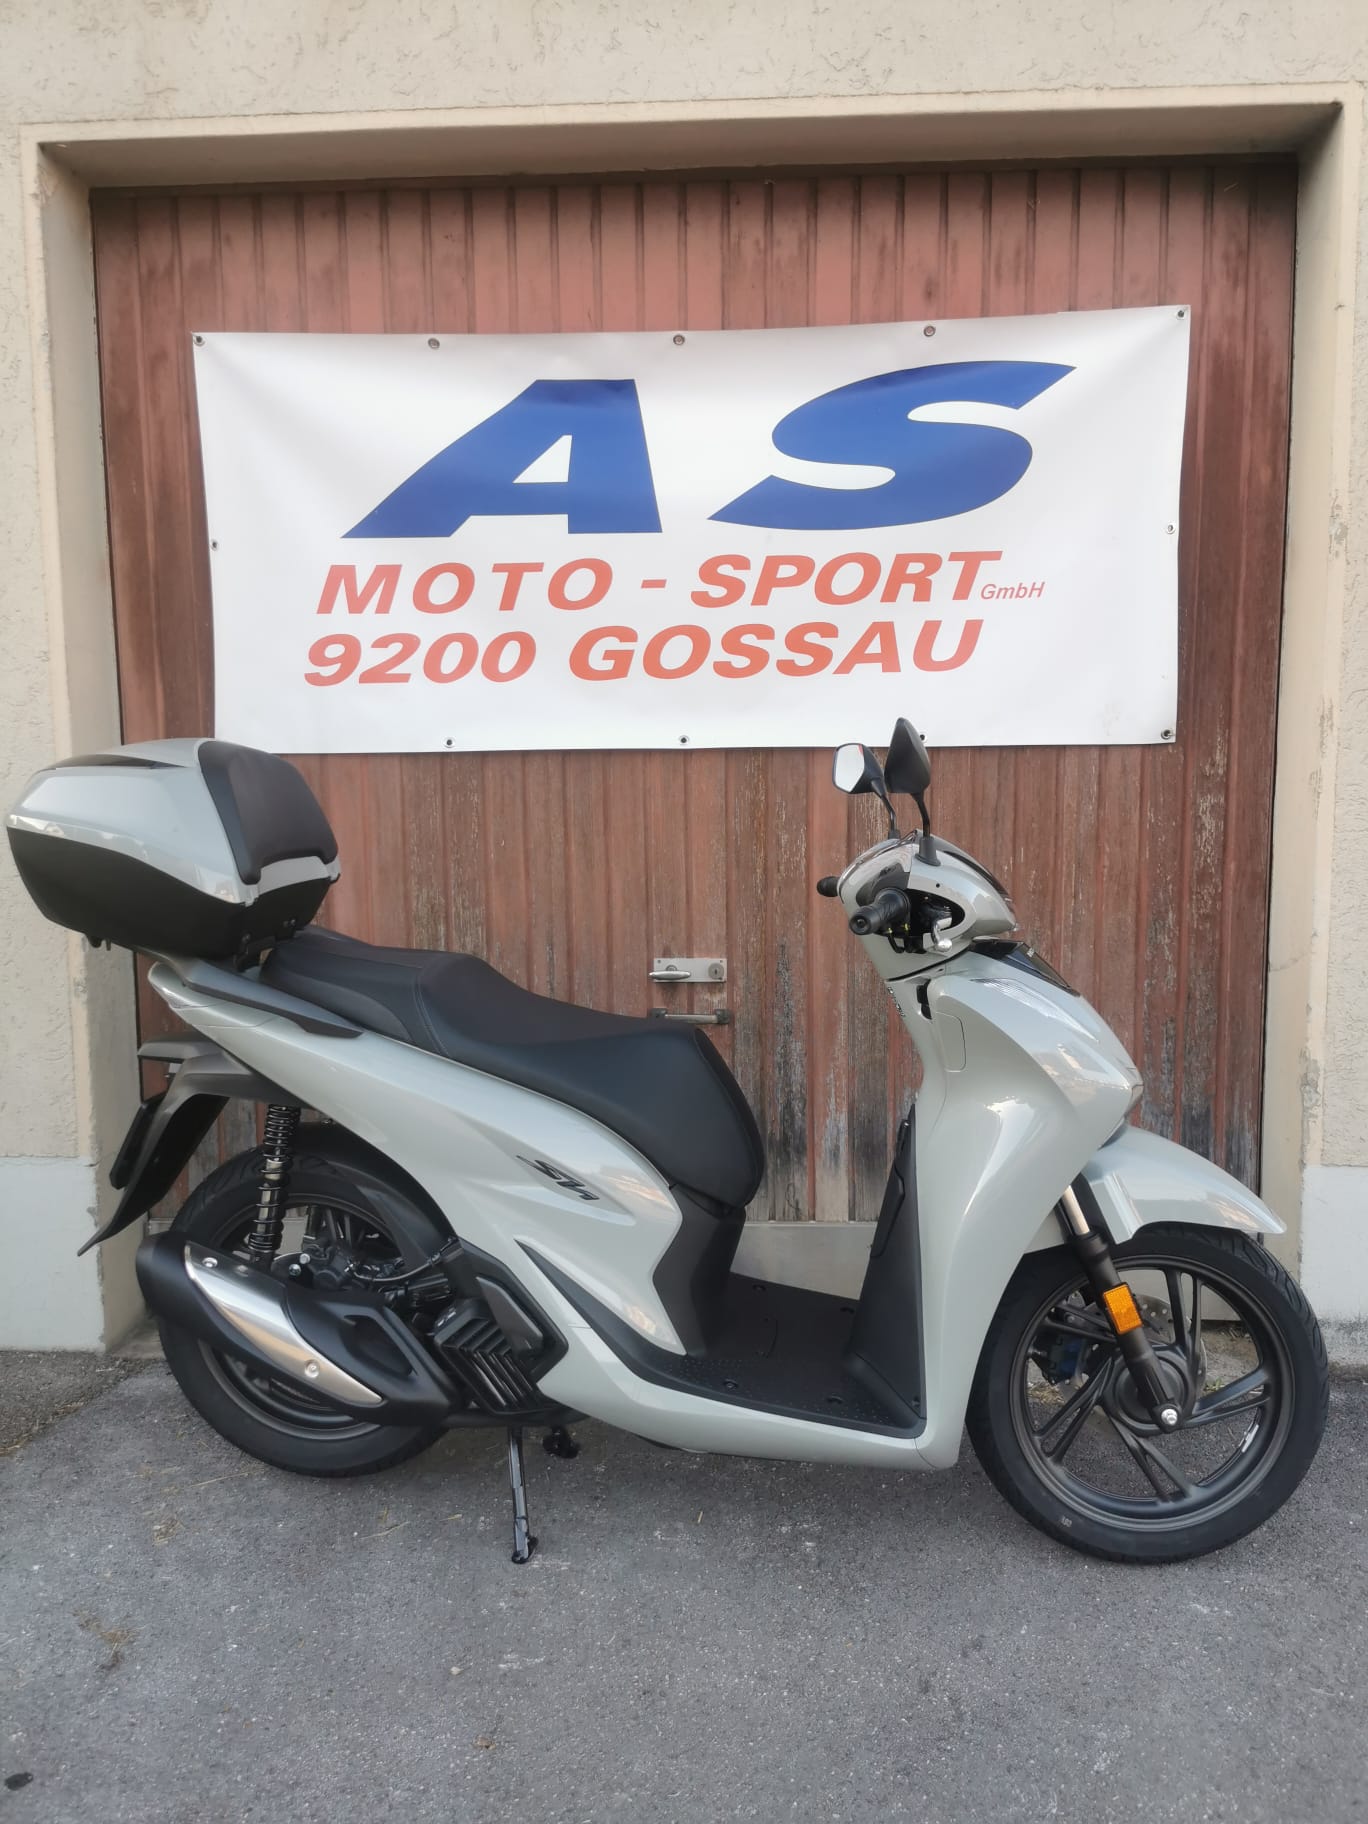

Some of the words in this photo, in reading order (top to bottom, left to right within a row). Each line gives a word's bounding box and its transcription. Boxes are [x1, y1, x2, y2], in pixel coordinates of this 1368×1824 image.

[316, 557, 613, 615] MOTO
[690, 550, 1003, 609] SPORT
[980, 581, 1046, 600] GmbH
[304, 630, 536, 688] 9200
[568, 619, 983, 682] GOSSAU
